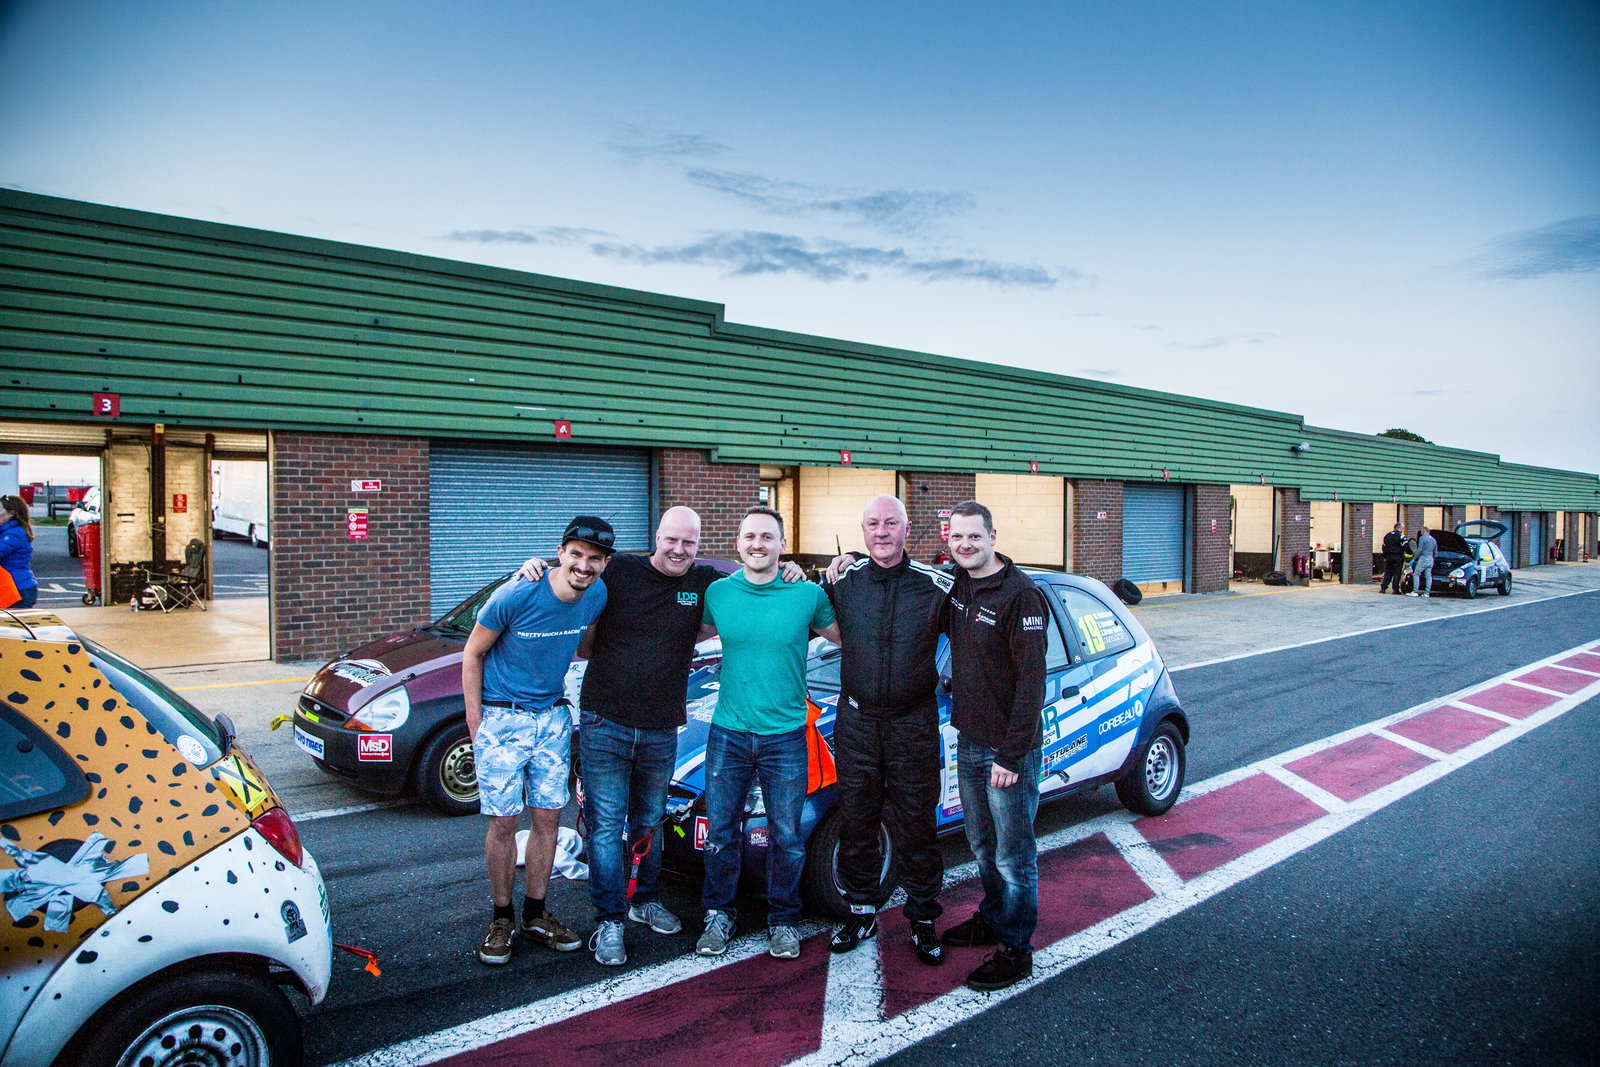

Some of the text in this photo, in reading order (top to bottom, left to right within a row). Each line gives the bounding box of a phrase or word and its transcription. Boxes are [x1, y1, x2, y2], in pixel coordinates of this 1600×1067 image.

[102, 399, 111, 411] 3
[560, 425, 568, 434] 4
[677, 592, 699, 606] LDR
[1022, 616, 1043, 626] MINI
[563, 628, 581, 636] RACIN
[1078, 614, 1106, 655] 19
[1098, 706, 1136, 735] CORBEAU
[305, 737, 323, 754] TIRES
[360, 739, 389, 752] MsD
[1049, 734, 1088, 762] STULANE
